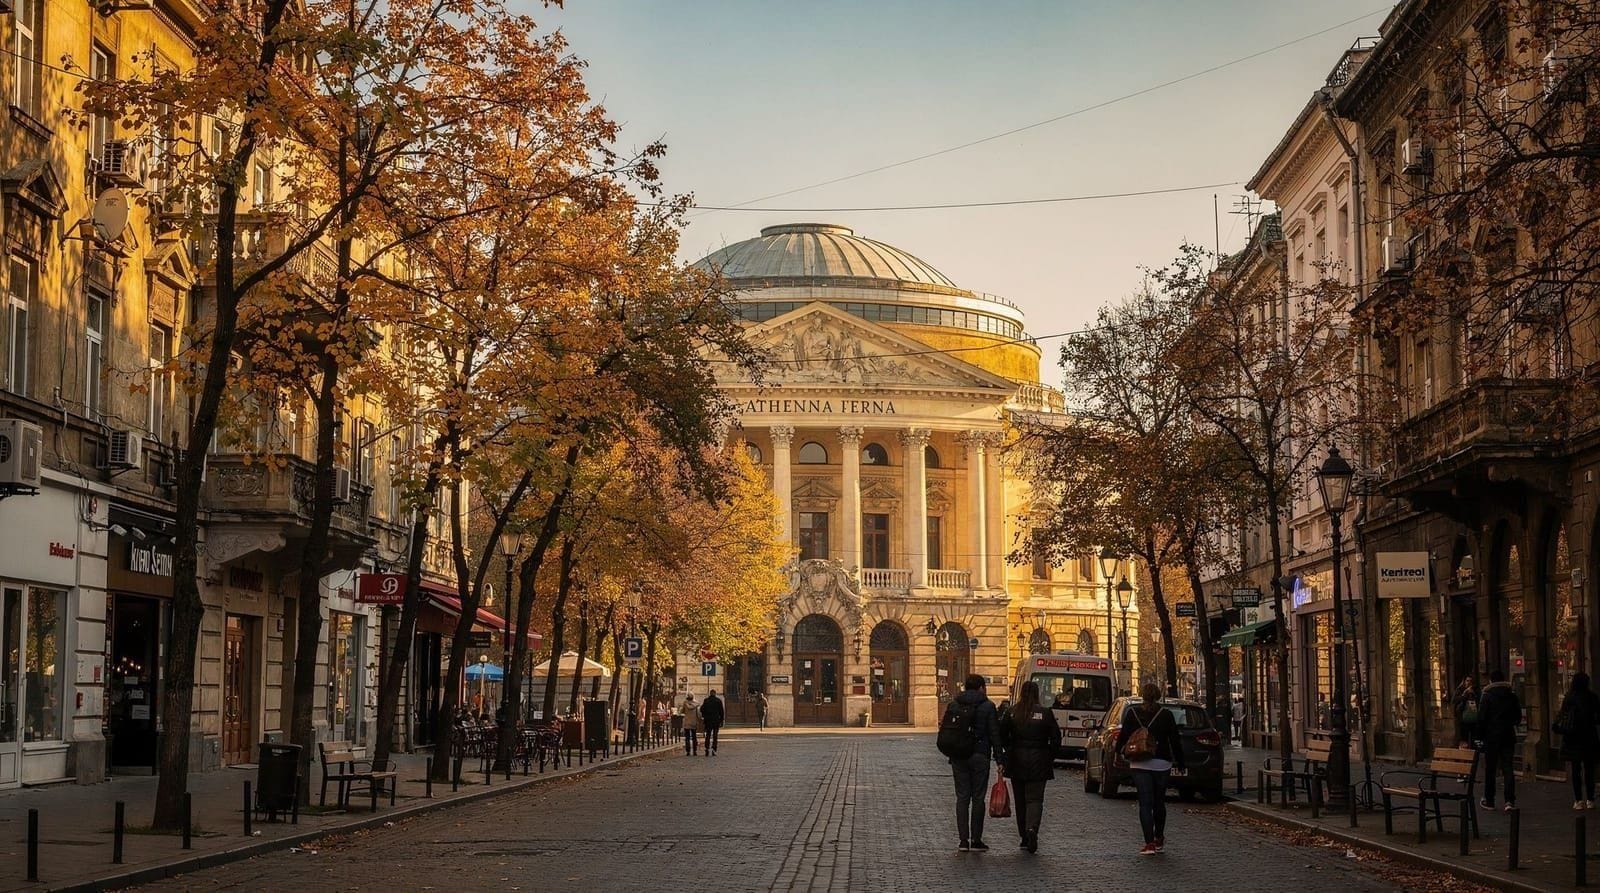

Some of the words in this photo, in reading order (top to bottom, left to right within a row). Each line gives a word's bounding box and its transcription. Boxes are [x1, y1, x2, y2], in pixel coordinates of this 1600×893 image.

[745, 399, 832, 413] ATHENNA
[627, 641, 639, 656] P
[705, 663, 712, 675] P
